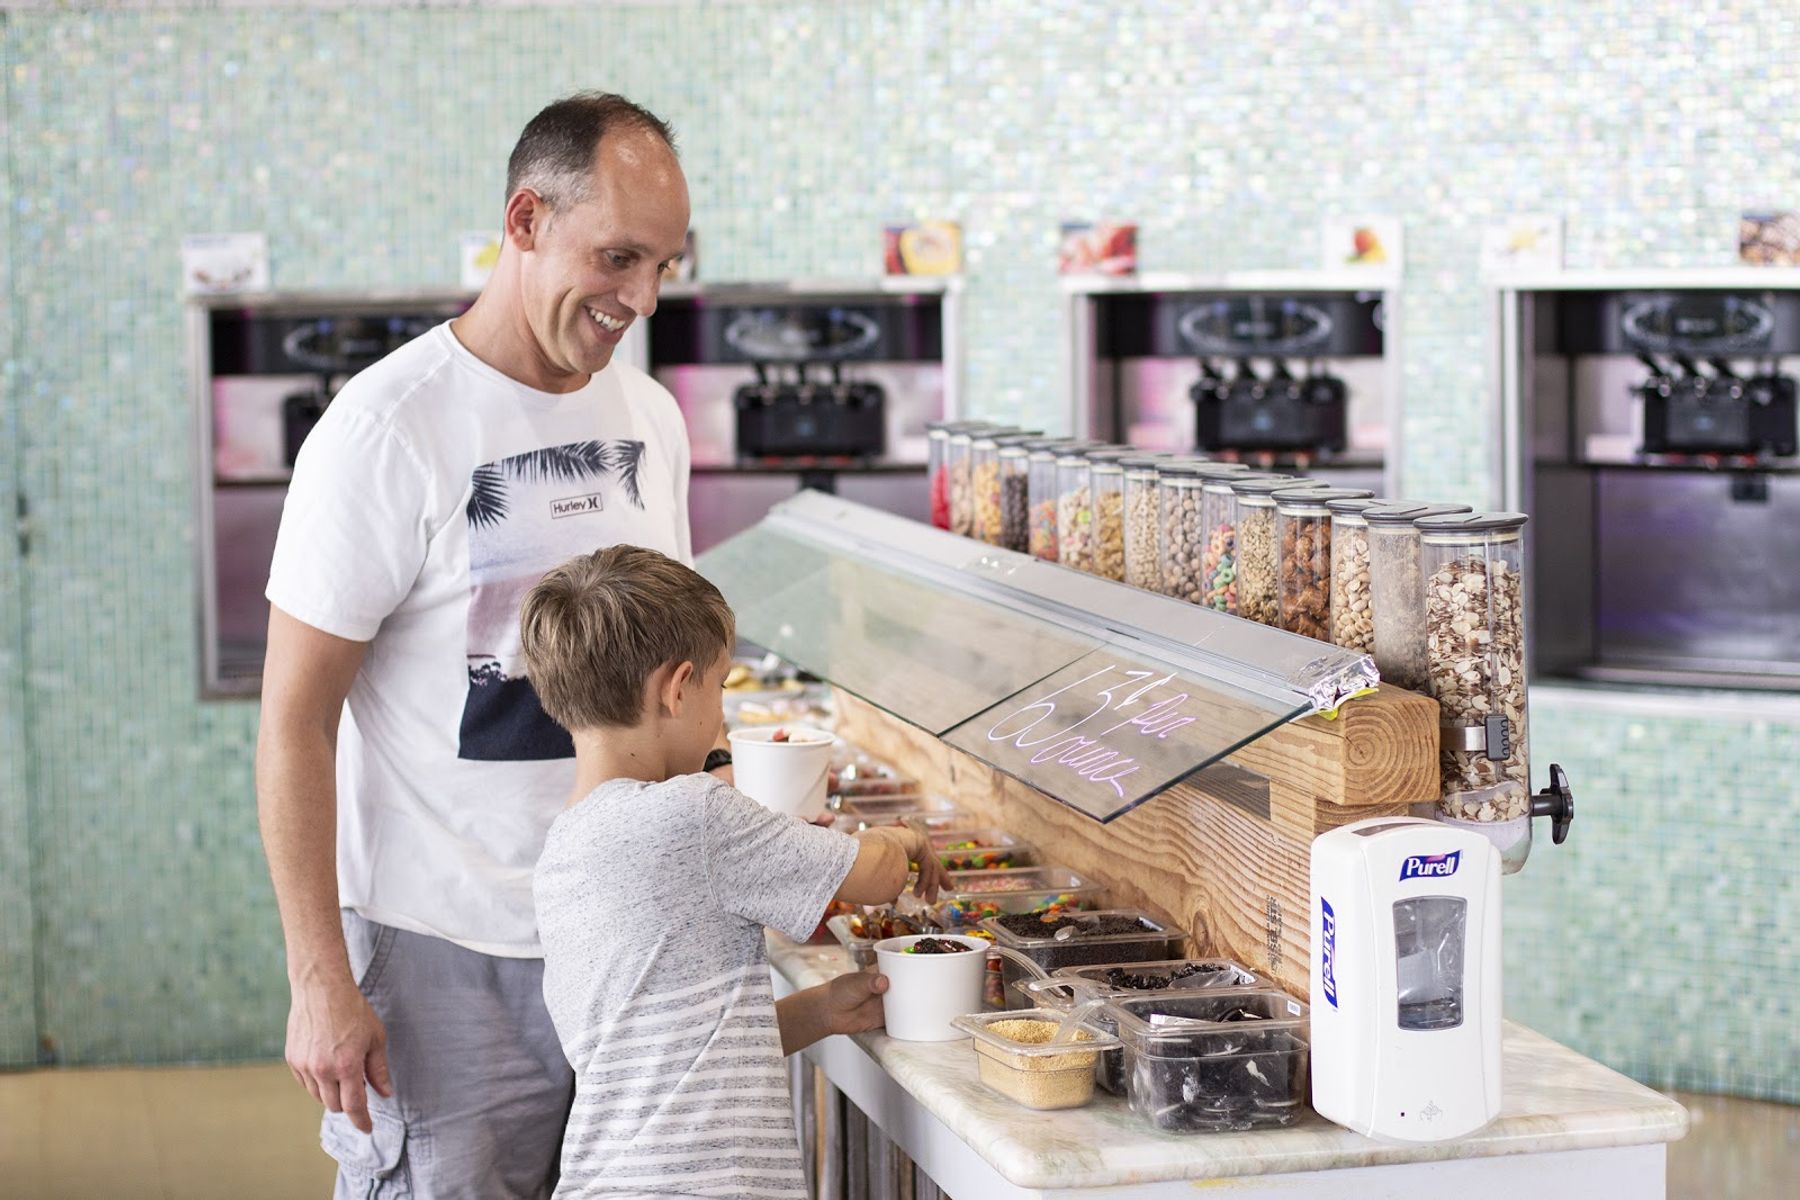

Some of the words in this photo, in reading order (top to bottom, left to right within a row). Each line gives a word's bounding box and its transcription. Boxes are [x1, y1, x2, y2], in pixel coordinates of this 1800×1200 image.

[553, 500, 586, 514] Hurley
[1404, 855, 1457, 877] Purell
[1322, 911, 1336, 997] Purell
